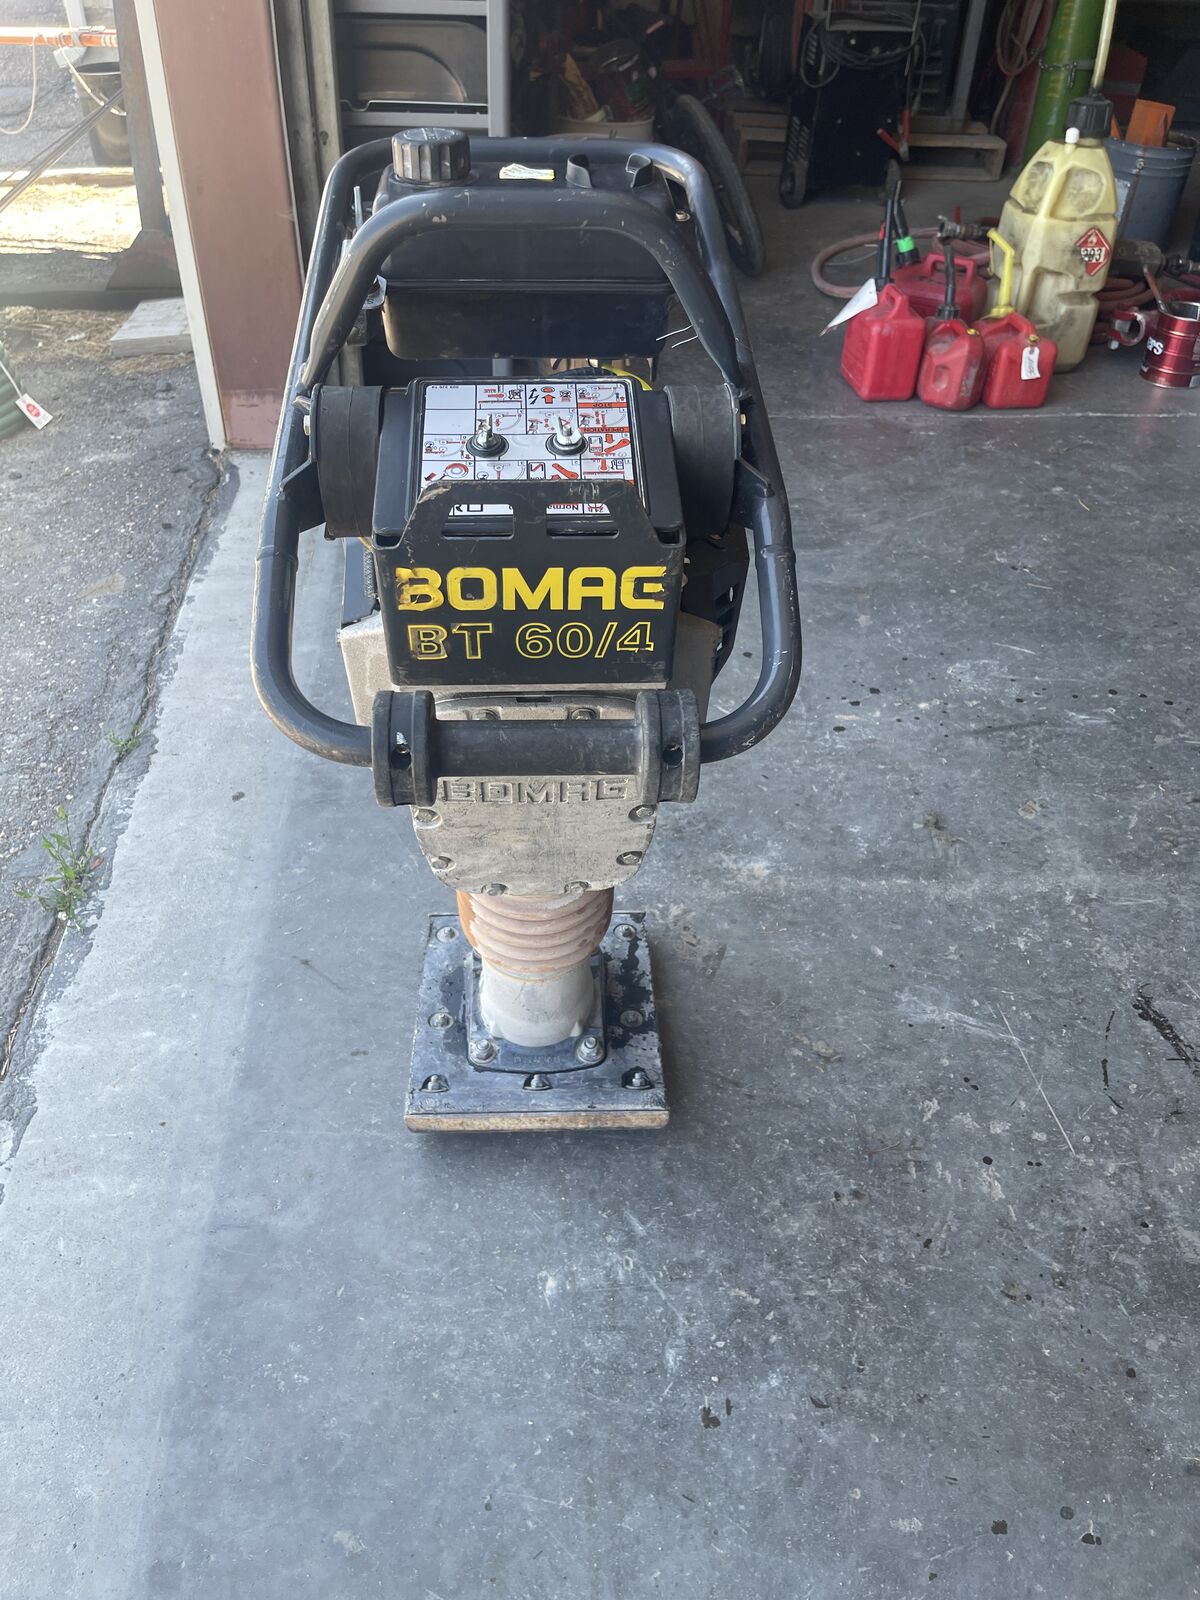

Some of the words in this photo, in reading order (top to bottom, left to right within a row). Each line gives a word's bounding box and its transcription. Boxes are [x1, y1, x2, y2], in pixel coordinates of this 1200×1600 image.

[395, 566, 667, 611] BOMAG
[407, 621, 493, 660] BT
[515, 621, 655, 659] 60/4
[442, 778, 630, 804] BOMAG
